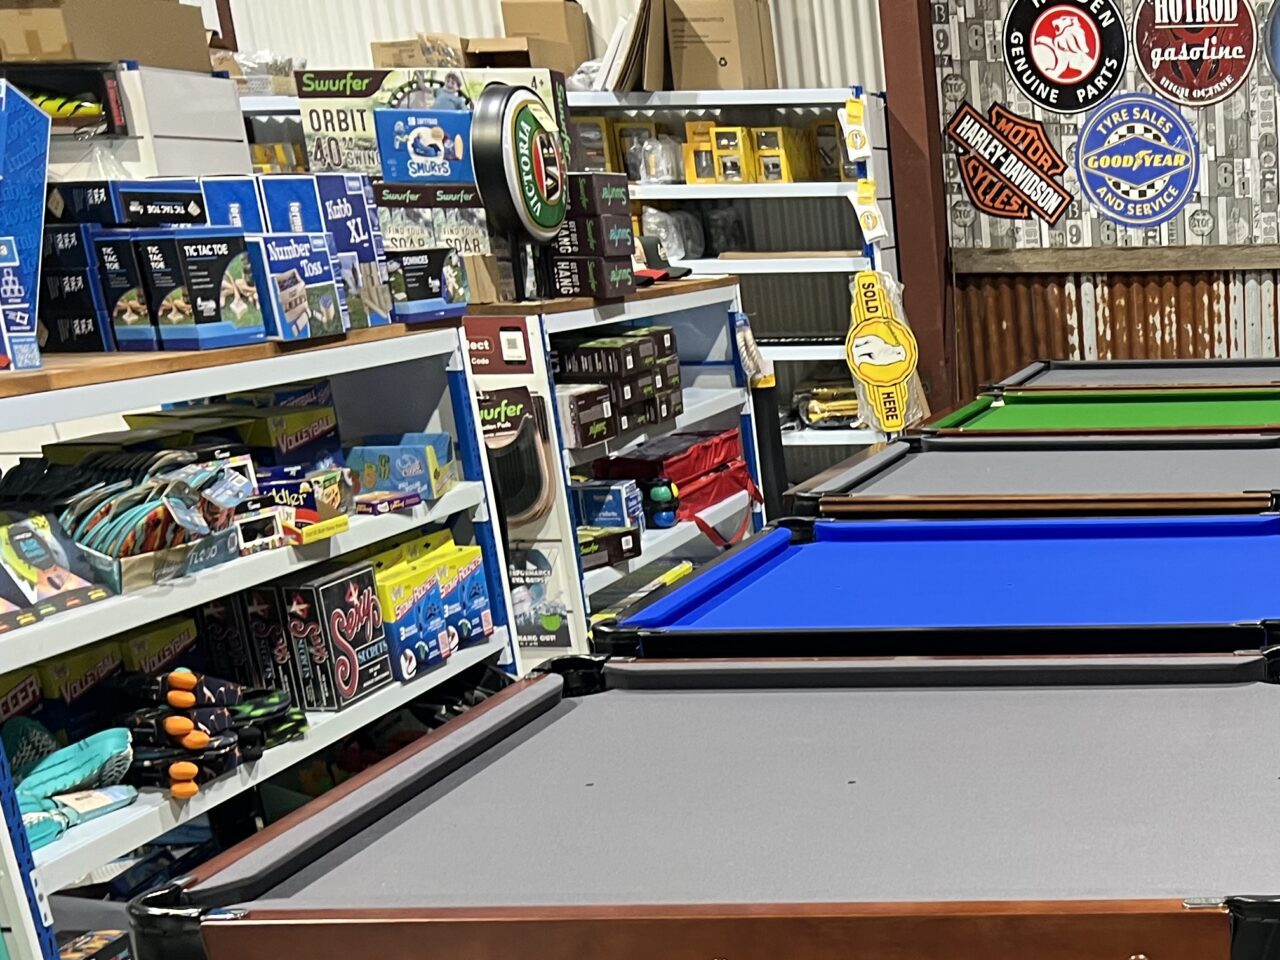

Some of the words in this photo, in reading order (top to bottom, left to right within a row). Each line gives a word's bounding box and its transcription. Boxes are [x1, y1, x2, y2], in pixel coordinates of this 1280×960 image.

[1150, 35, 1246, 70] gasoline
[1010, 31, 1059, 104] GENUINE
[1076, 57, 1118, 103] PARTS
[302, 72, 372, 97] Swurfer
[530, 75, 545, 91] 4+
[1160, 76, 1190, 98] HIGH
[1192, 74, 1235, 98] OCTANE
[308, 108, 367, 133] ORBIT
[555, 80, 572, 166] Swurfer
[1096, 108, 1130, 135] TYRE
[1132, 107, 1174, 134] SALES
[997, 119, 1053, 172] MOTOR
[515, 119, 542, 217] VICTORIA
[955, 114, 1063, 215] HARLEY-DAVIDSON
[1087, 150, 1186, 172] GOODYEAR
[382, 189, 421, 203] Swurfer
[436, 190, 475, 203] Swurfer
[602, 181, 627, 207] Swurfer
[1096, 186, 1125, 211] AND
[1126, 184, 1179, 216] SERVICE
[324, 197, 353, 220] Kubb
[346, 217, 369, 244] XL
[609, 223, 632, 249] Swurfer
[101, 246, 114, 256] TIC
[146, 245, 160, 255] TIC
[148, 254, 163, 262] TAC
[183, 245, 198, 257] TIC
[196, 244, 212, 256] TAC
[212, 243, 229, 255] TOE
[267, 238, 311, 262] Number
[446, 238, 481, 254] SOAR
[103, 255, 118, 263] TAC
[105, 262, 121, 271] TOE
[150, 261, 166, 270] TOE
[300, 259, 323, 278] Toss
[557, 261, 574, 295] HANG
[610, 264, 633, 289] Swurfer
[861, 282, 879, 314] SOLD
[471, 357, 490, 365] Code
[881, 391, 899, 422] HERE
[277, 415, 336, 454] VOLLEYBALL
[329, 586, 383, 699] Sexy
